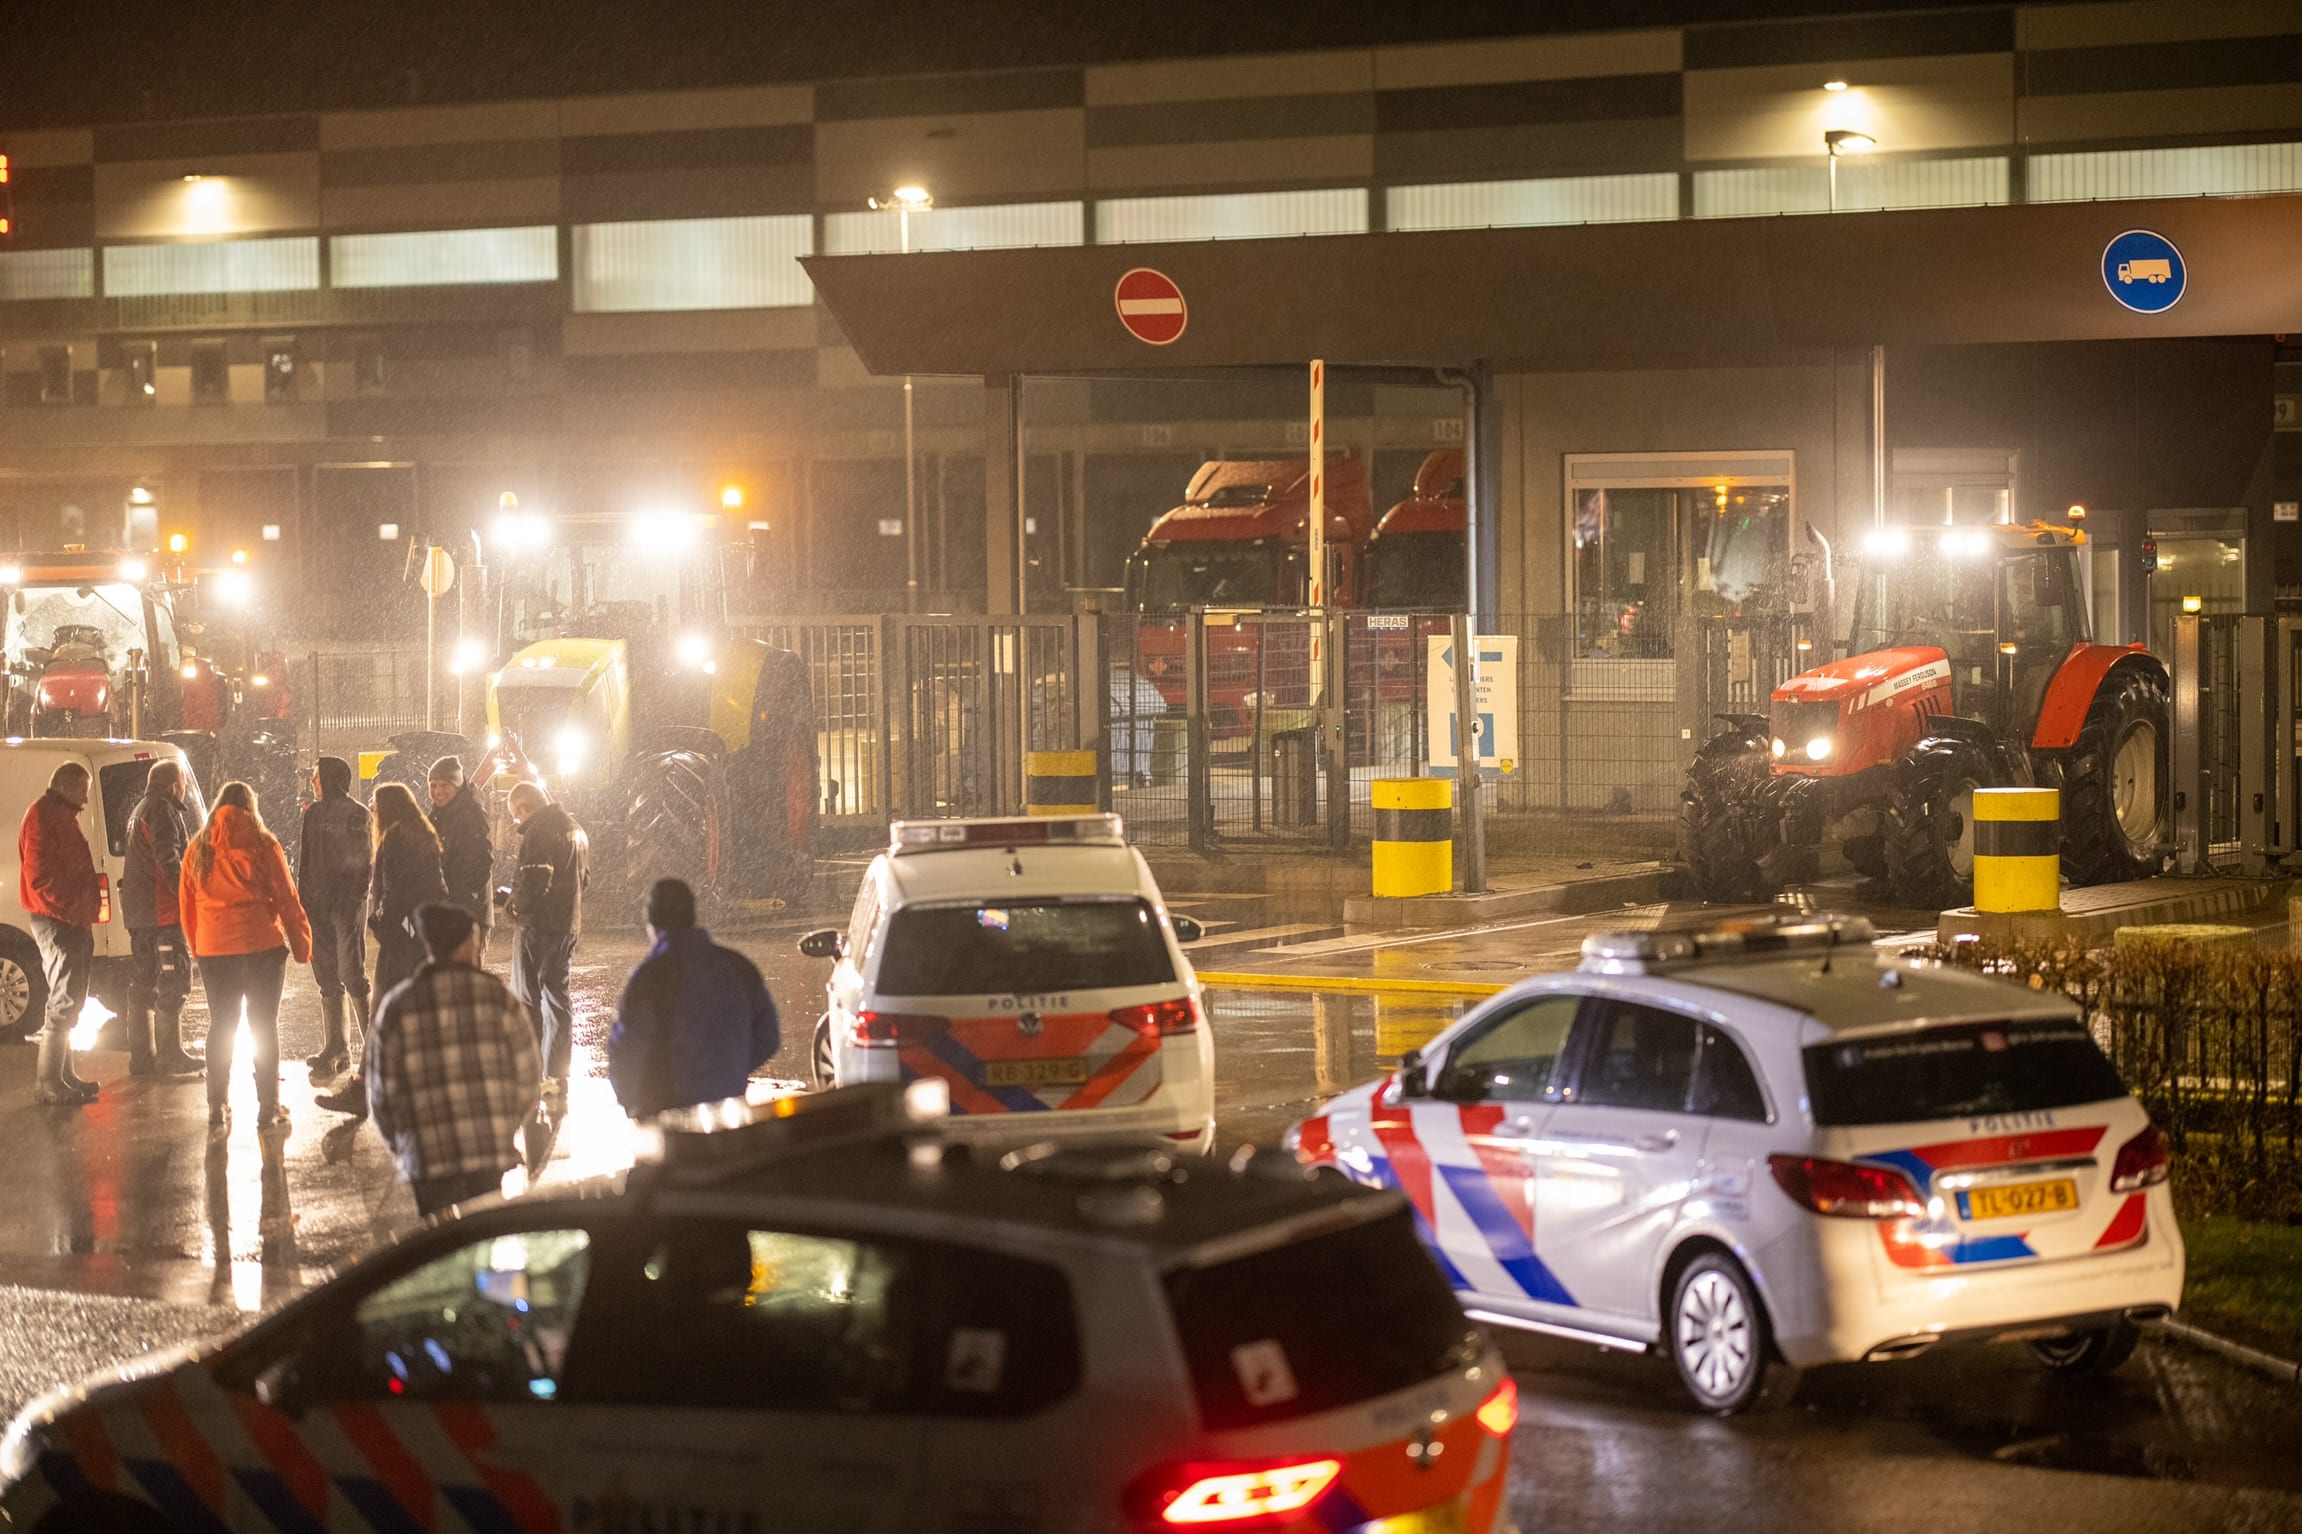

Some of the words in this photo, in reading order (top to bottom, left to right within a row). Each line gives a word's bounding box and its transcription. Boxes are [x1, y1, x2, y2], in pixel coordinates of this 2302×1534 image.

[1369, 617, 1407, 626] HERAS
[1893, 676, 1912, 690] MASSEY
[1912, 668, 1937, 682] FERGUSON
[988, 995, 1068, 1009] POLITIE
[1970, 1111, 2053, 1133] POLITIE
[1977, 1184, 2068, 1213] TL-027-B
